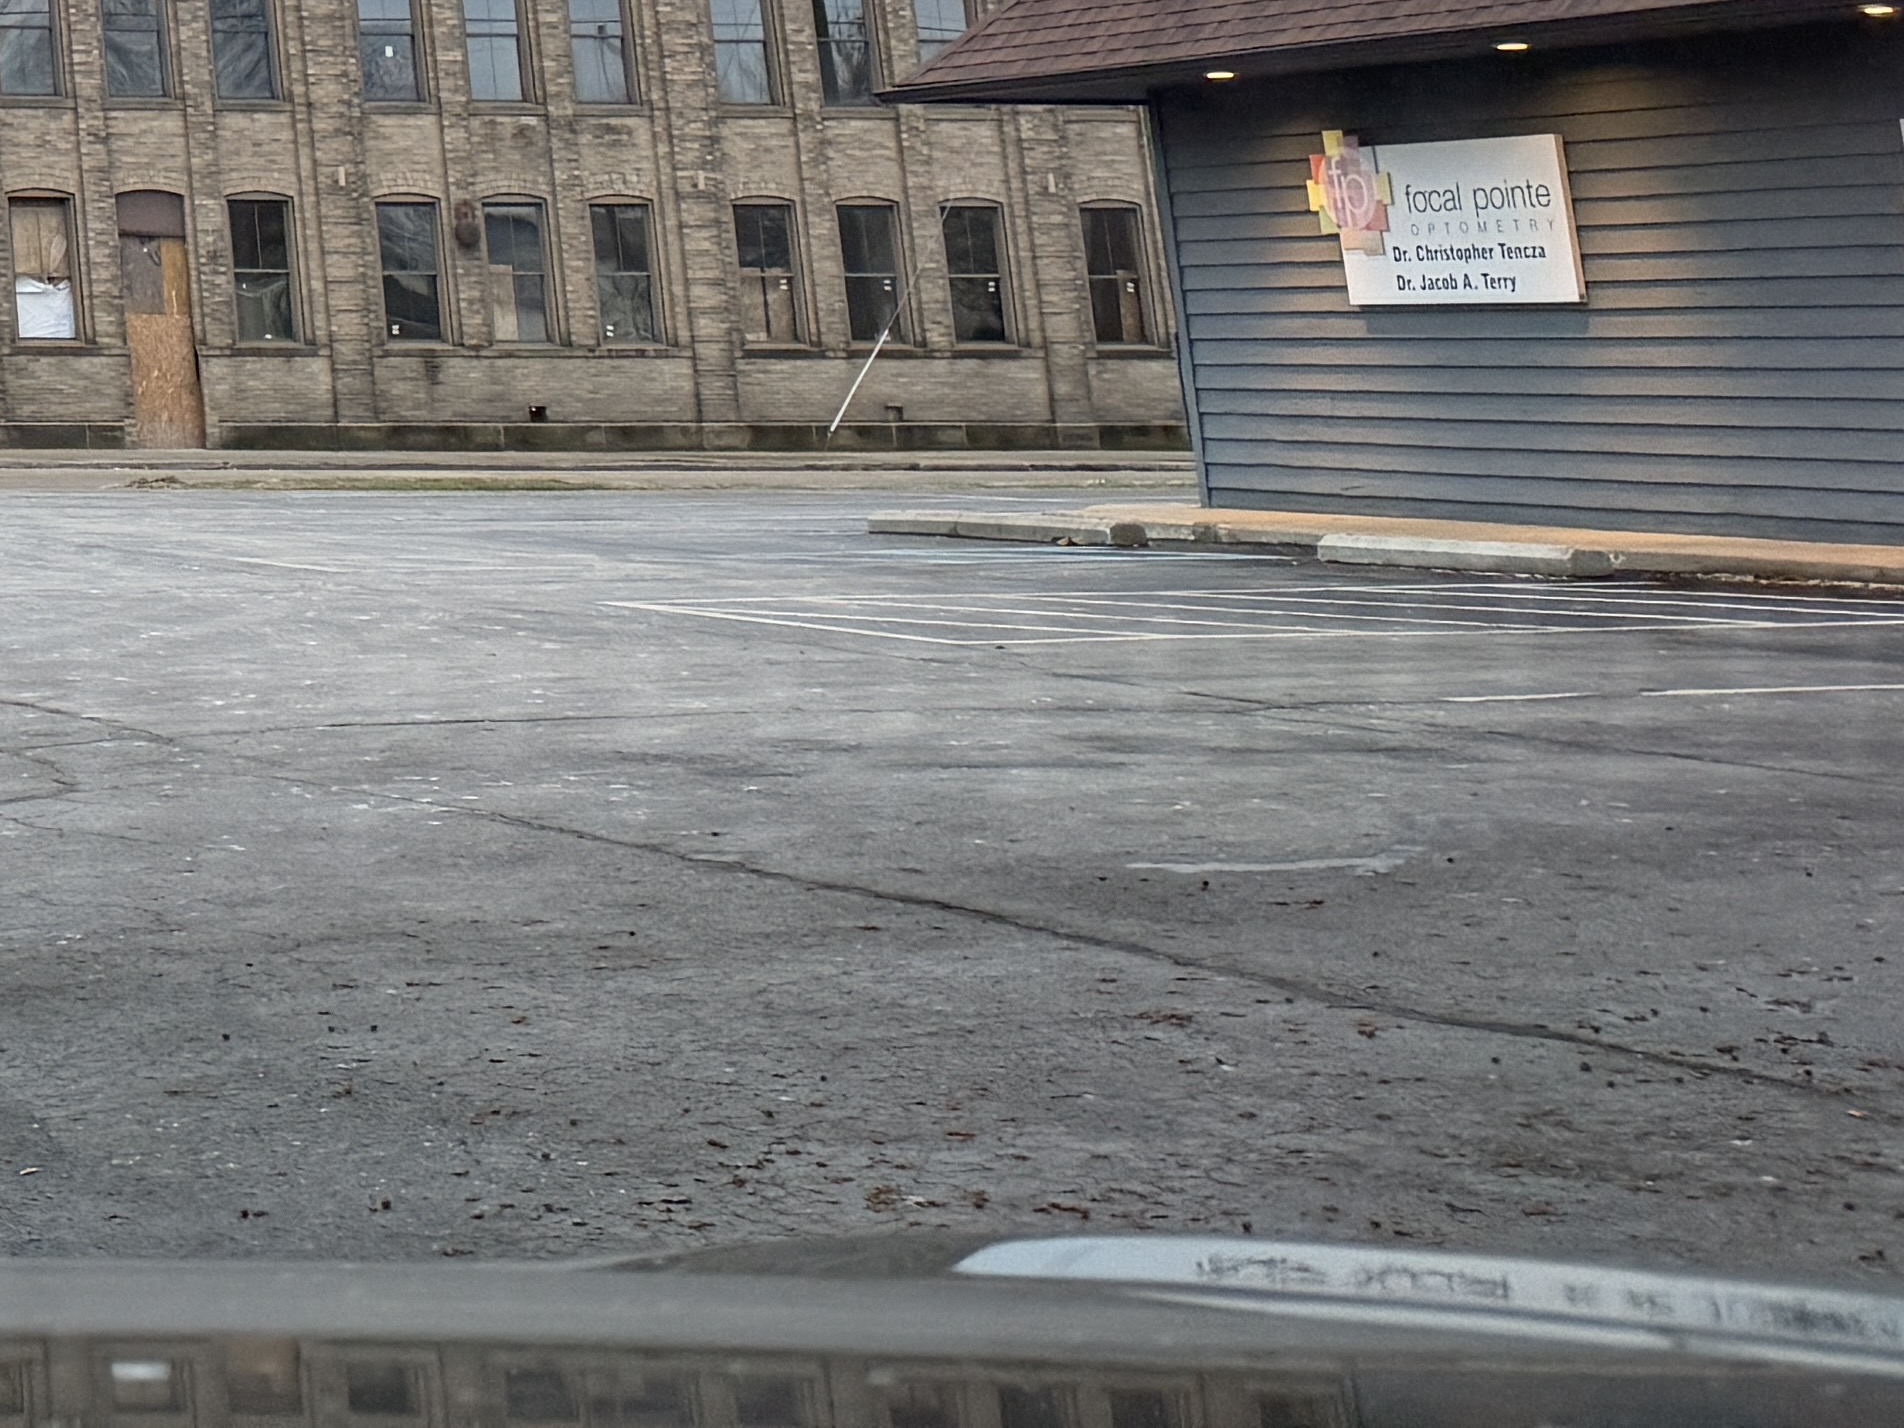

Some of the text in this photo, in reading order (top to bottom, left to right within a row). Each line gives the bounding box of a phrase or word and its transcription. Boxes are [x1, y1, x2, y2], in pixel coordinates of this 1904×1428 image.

[1405, 179, 1551, 218] focal pointe
[1411, 218, 1555, 237] OPTOMETRY
[1393, 242, 1547, 264] Dr. Christopher Tencza
[1396, 272, 1517, 293] Dr. Jacob A. Terry
